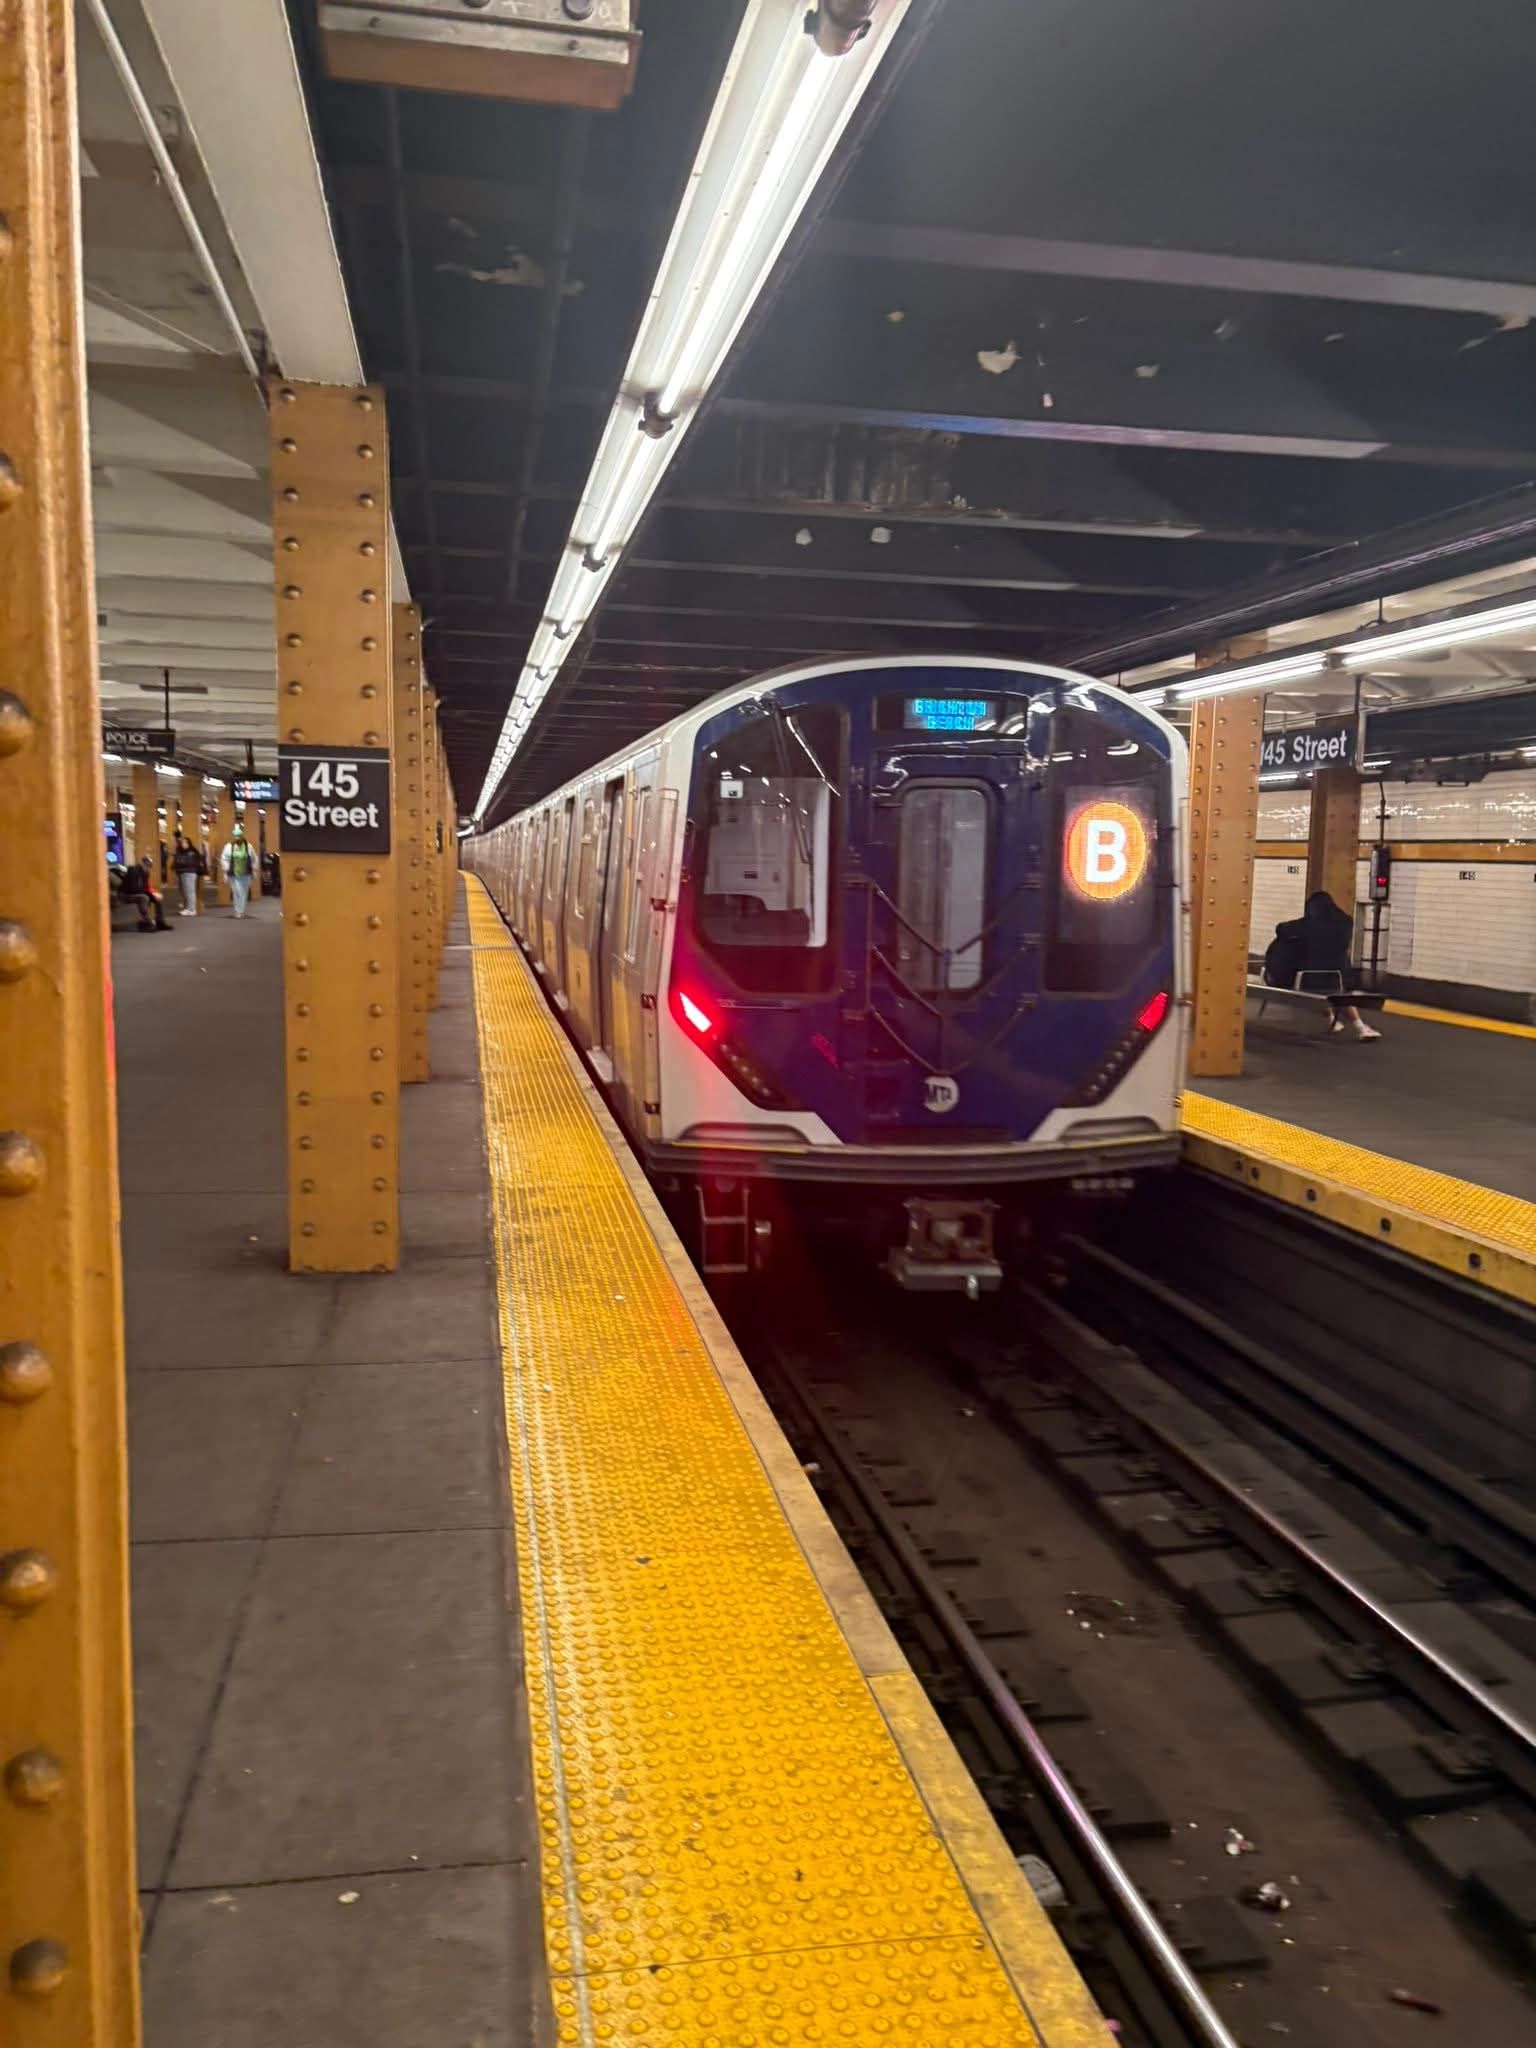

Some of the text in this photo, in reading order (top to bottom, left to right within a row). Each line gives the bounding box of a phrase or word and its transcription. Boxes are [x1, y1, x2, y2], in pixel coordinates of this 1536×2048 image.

[1260, 730, 1347, 766] 145 Street
[291, 761, 359, 799] 145
[284, 798, 379, 828] Street
[1086, 819, 1127, 883] B
